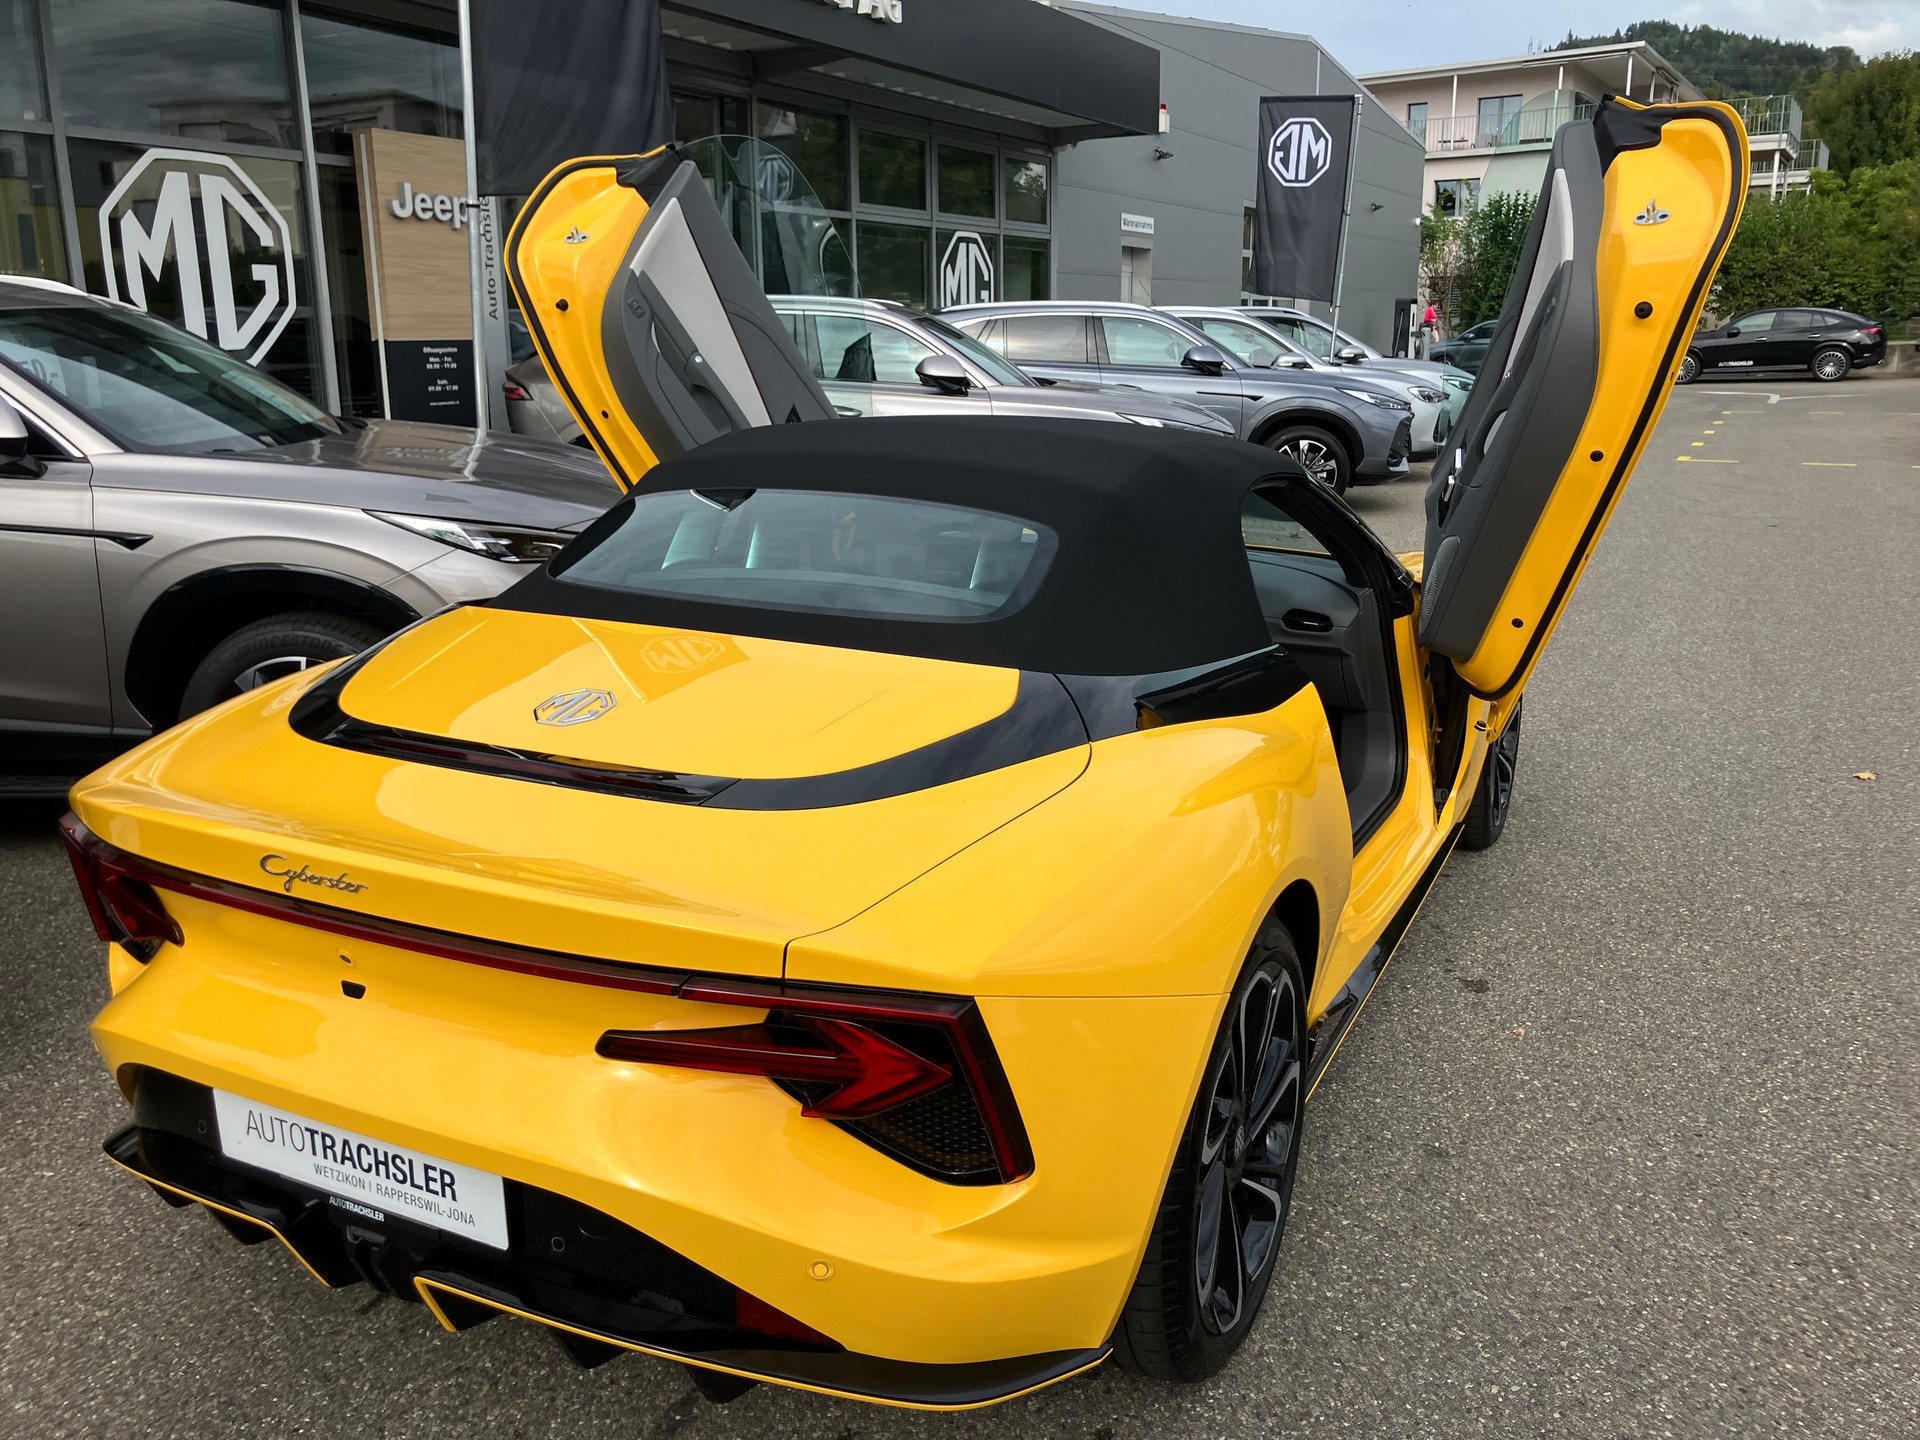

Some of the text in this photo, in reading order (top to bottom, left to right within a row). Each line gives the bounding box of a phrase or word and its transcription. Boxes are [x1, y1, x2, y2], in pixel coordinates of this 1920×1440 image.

[390, 182, 468, 230] Jeep
[120, 171, 280, 350] MG
[480, 197, 498, 320] Auto-Trachsle
[945, 242, 990, 305] MG
[540, 690, 610, 723] MG
[260, 854, 369, 893] Cyberster
[246, 1109, 458, 1202] AUTOTRACHSLER
[313, 1163, 366, 1190] WETZIKON
[376, 1183, 476, 1227] RAPPERSWIL-JONA
[329, 1195, 385, 1223] AUTOTRACHSLER
